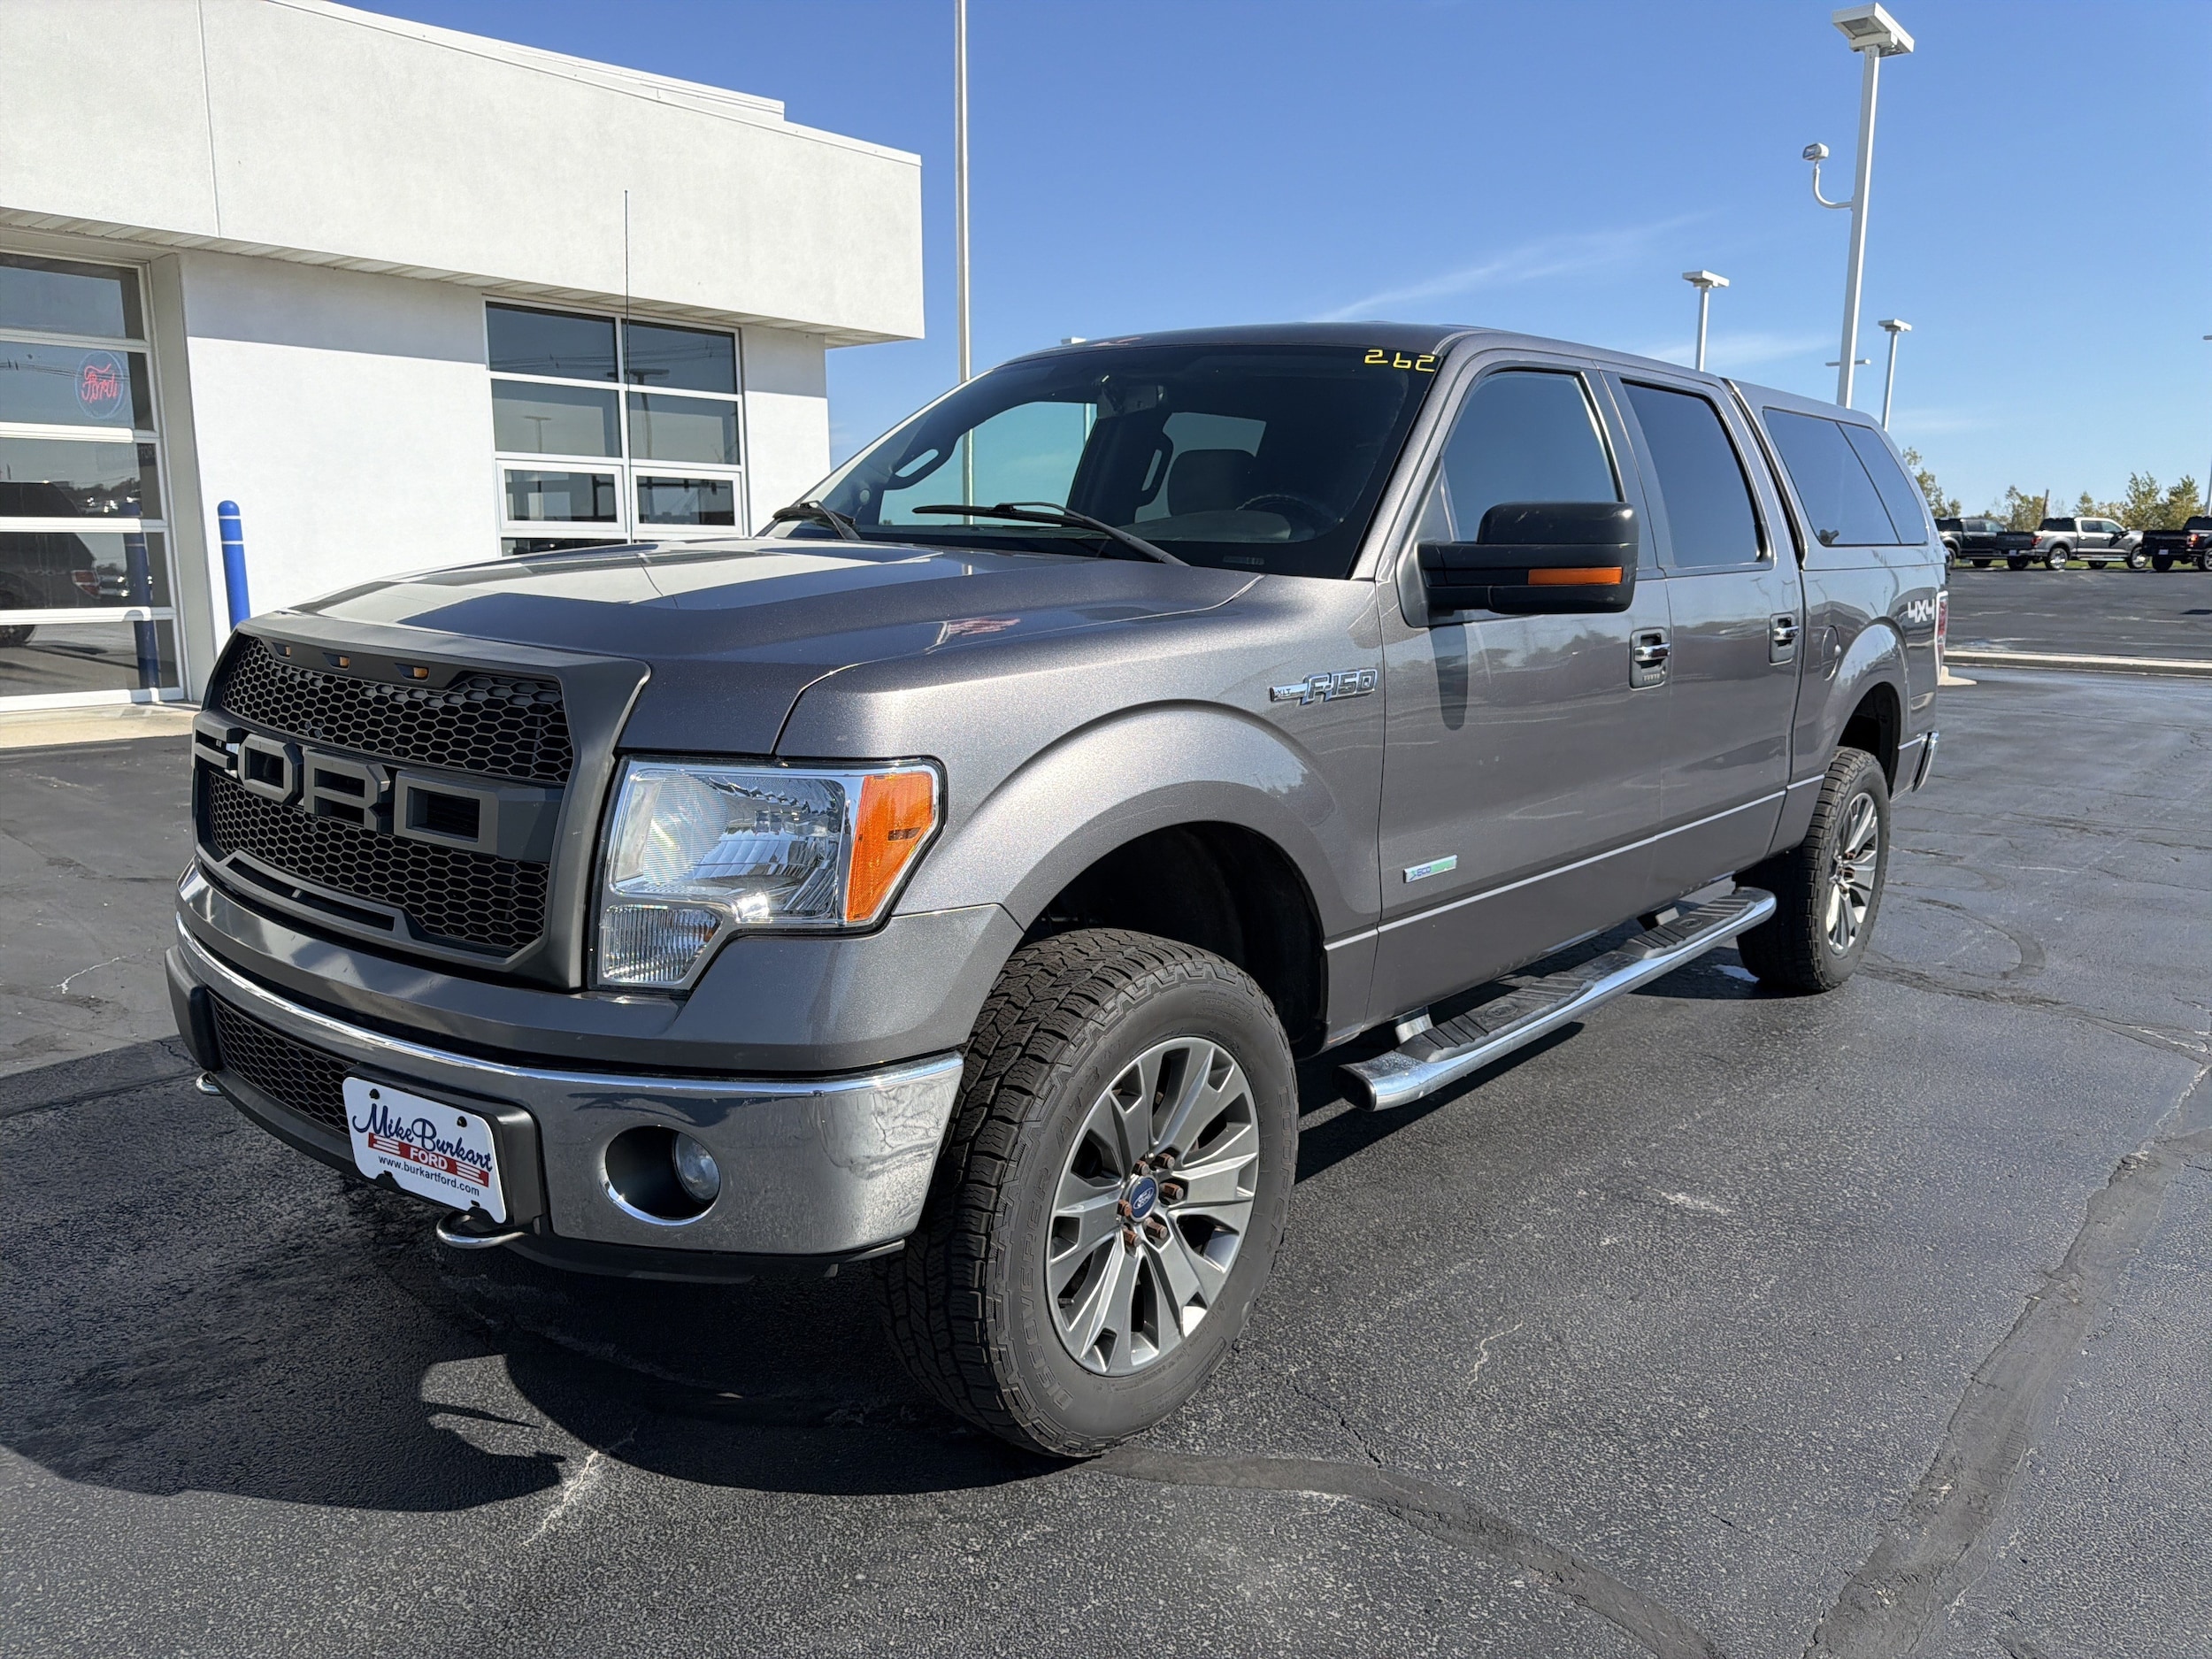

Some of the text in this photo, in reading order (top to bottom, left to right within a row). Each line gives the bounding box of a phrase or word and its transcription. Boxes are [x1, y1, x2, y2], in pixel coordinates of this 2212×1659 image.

[1363, 349, 1435, 373] 262
[81, 363, 118, 403] Ford
[192, 713, 499, 856] FORD
[351, 1103, 493, 1172] Mike Burkart
[378, 1155, 480, 1197] www.burkartford.com
[410, 1148, 449, 1171] FORD
